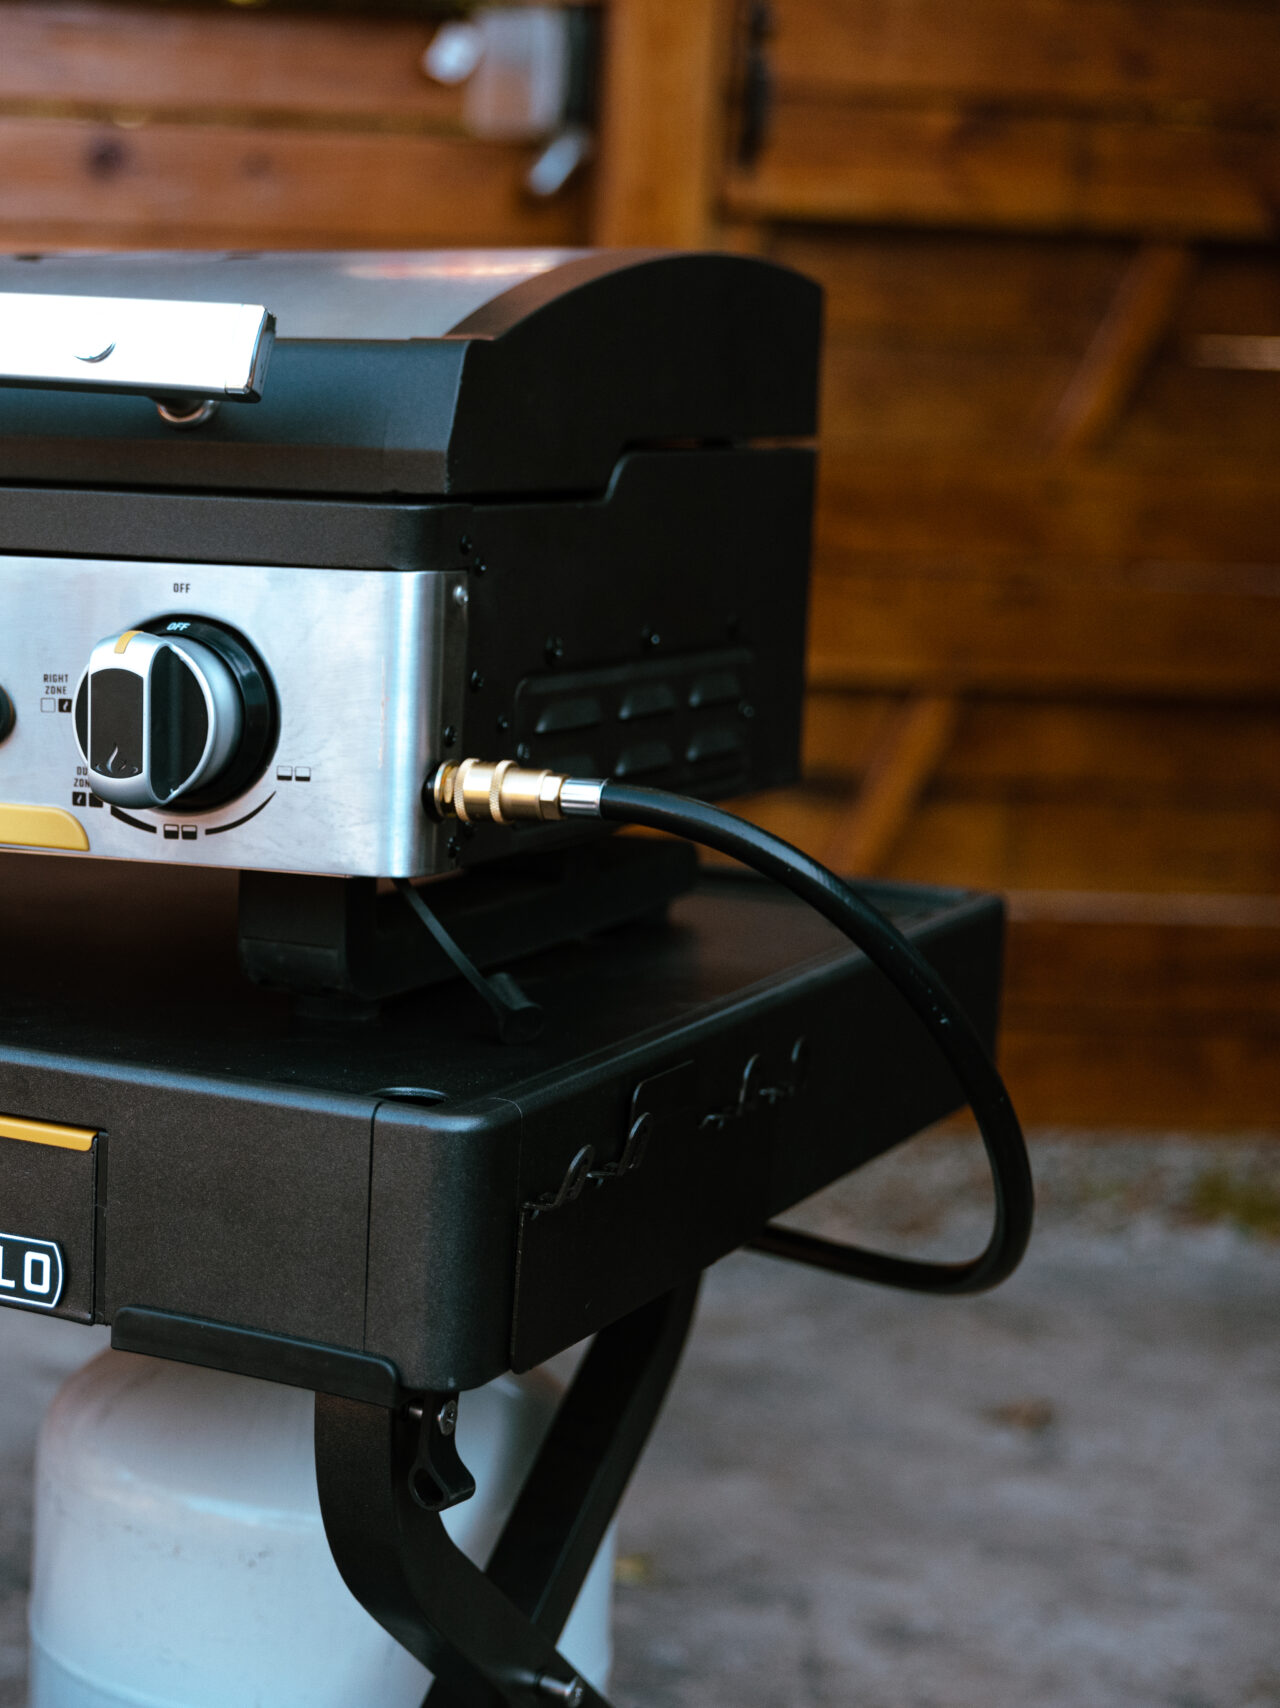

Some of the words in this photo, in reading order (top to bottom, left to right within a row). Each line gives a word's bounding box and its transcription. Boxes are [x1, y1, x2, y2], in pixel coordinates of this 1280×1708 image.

[173, 583, 191, 593] OFF
[166, 621, 191, 631] OFF
[43, 674, 69, 683] RIGHT
[45, 686, 67, 695] ZONE
[73, 778, 90, 788] ZON
